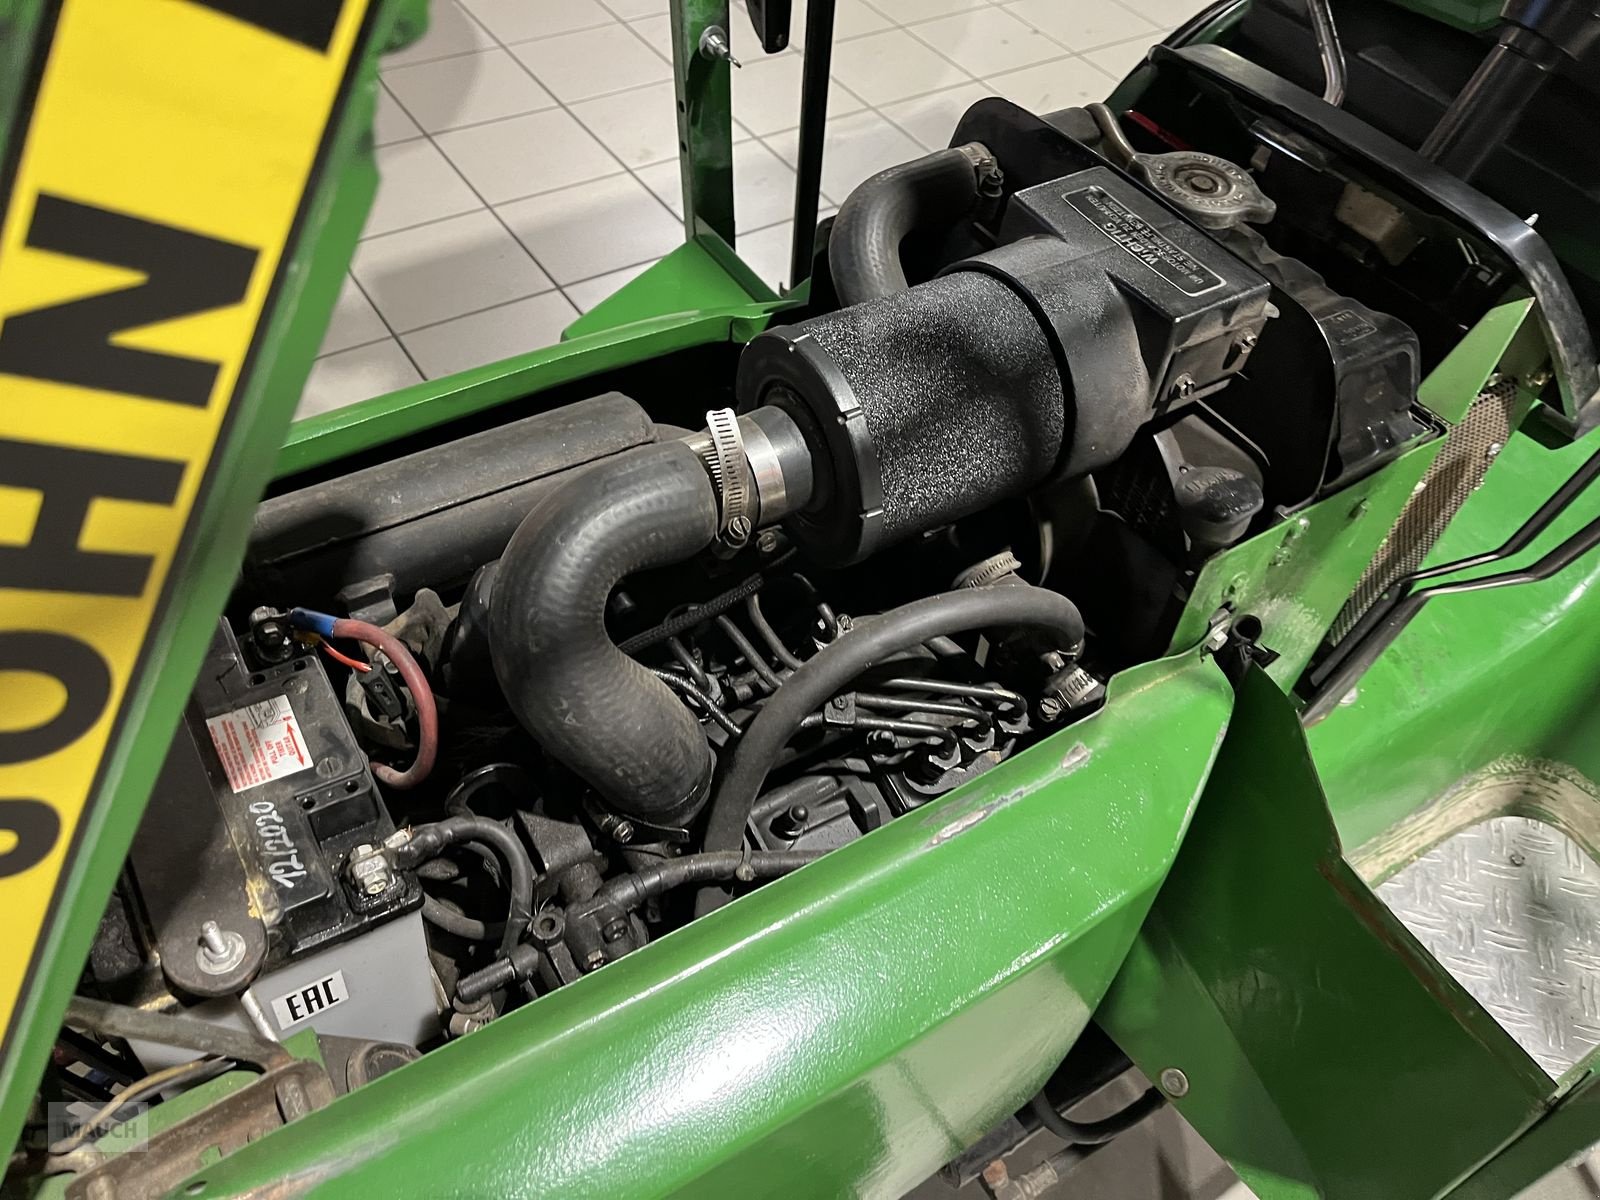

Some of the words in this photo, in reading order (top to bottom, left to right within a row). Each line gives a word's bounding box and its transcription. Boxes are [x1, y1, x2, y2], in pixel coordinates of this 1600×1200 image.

[1105, 200, 1144, 229] BENUTZEN
[1119, 222, 1133, 232] ZU
[1102, 221, 1158, 265] WICHTIG
[1140, 227, 1185, 261] STARTHILFE
[1183, 259, 1199, 271] NIE
[0, 190, 261, 880] OHN
[264, 739, 273, 750] OFF
[274, 740, 286, 757] TIRER
[282, 735, 295, 756] QUITAR
[268, 750, 279, 765] PULL
[249, 801, 307, 887] 12/2020
[285, 977, 340, 1021] EAC
